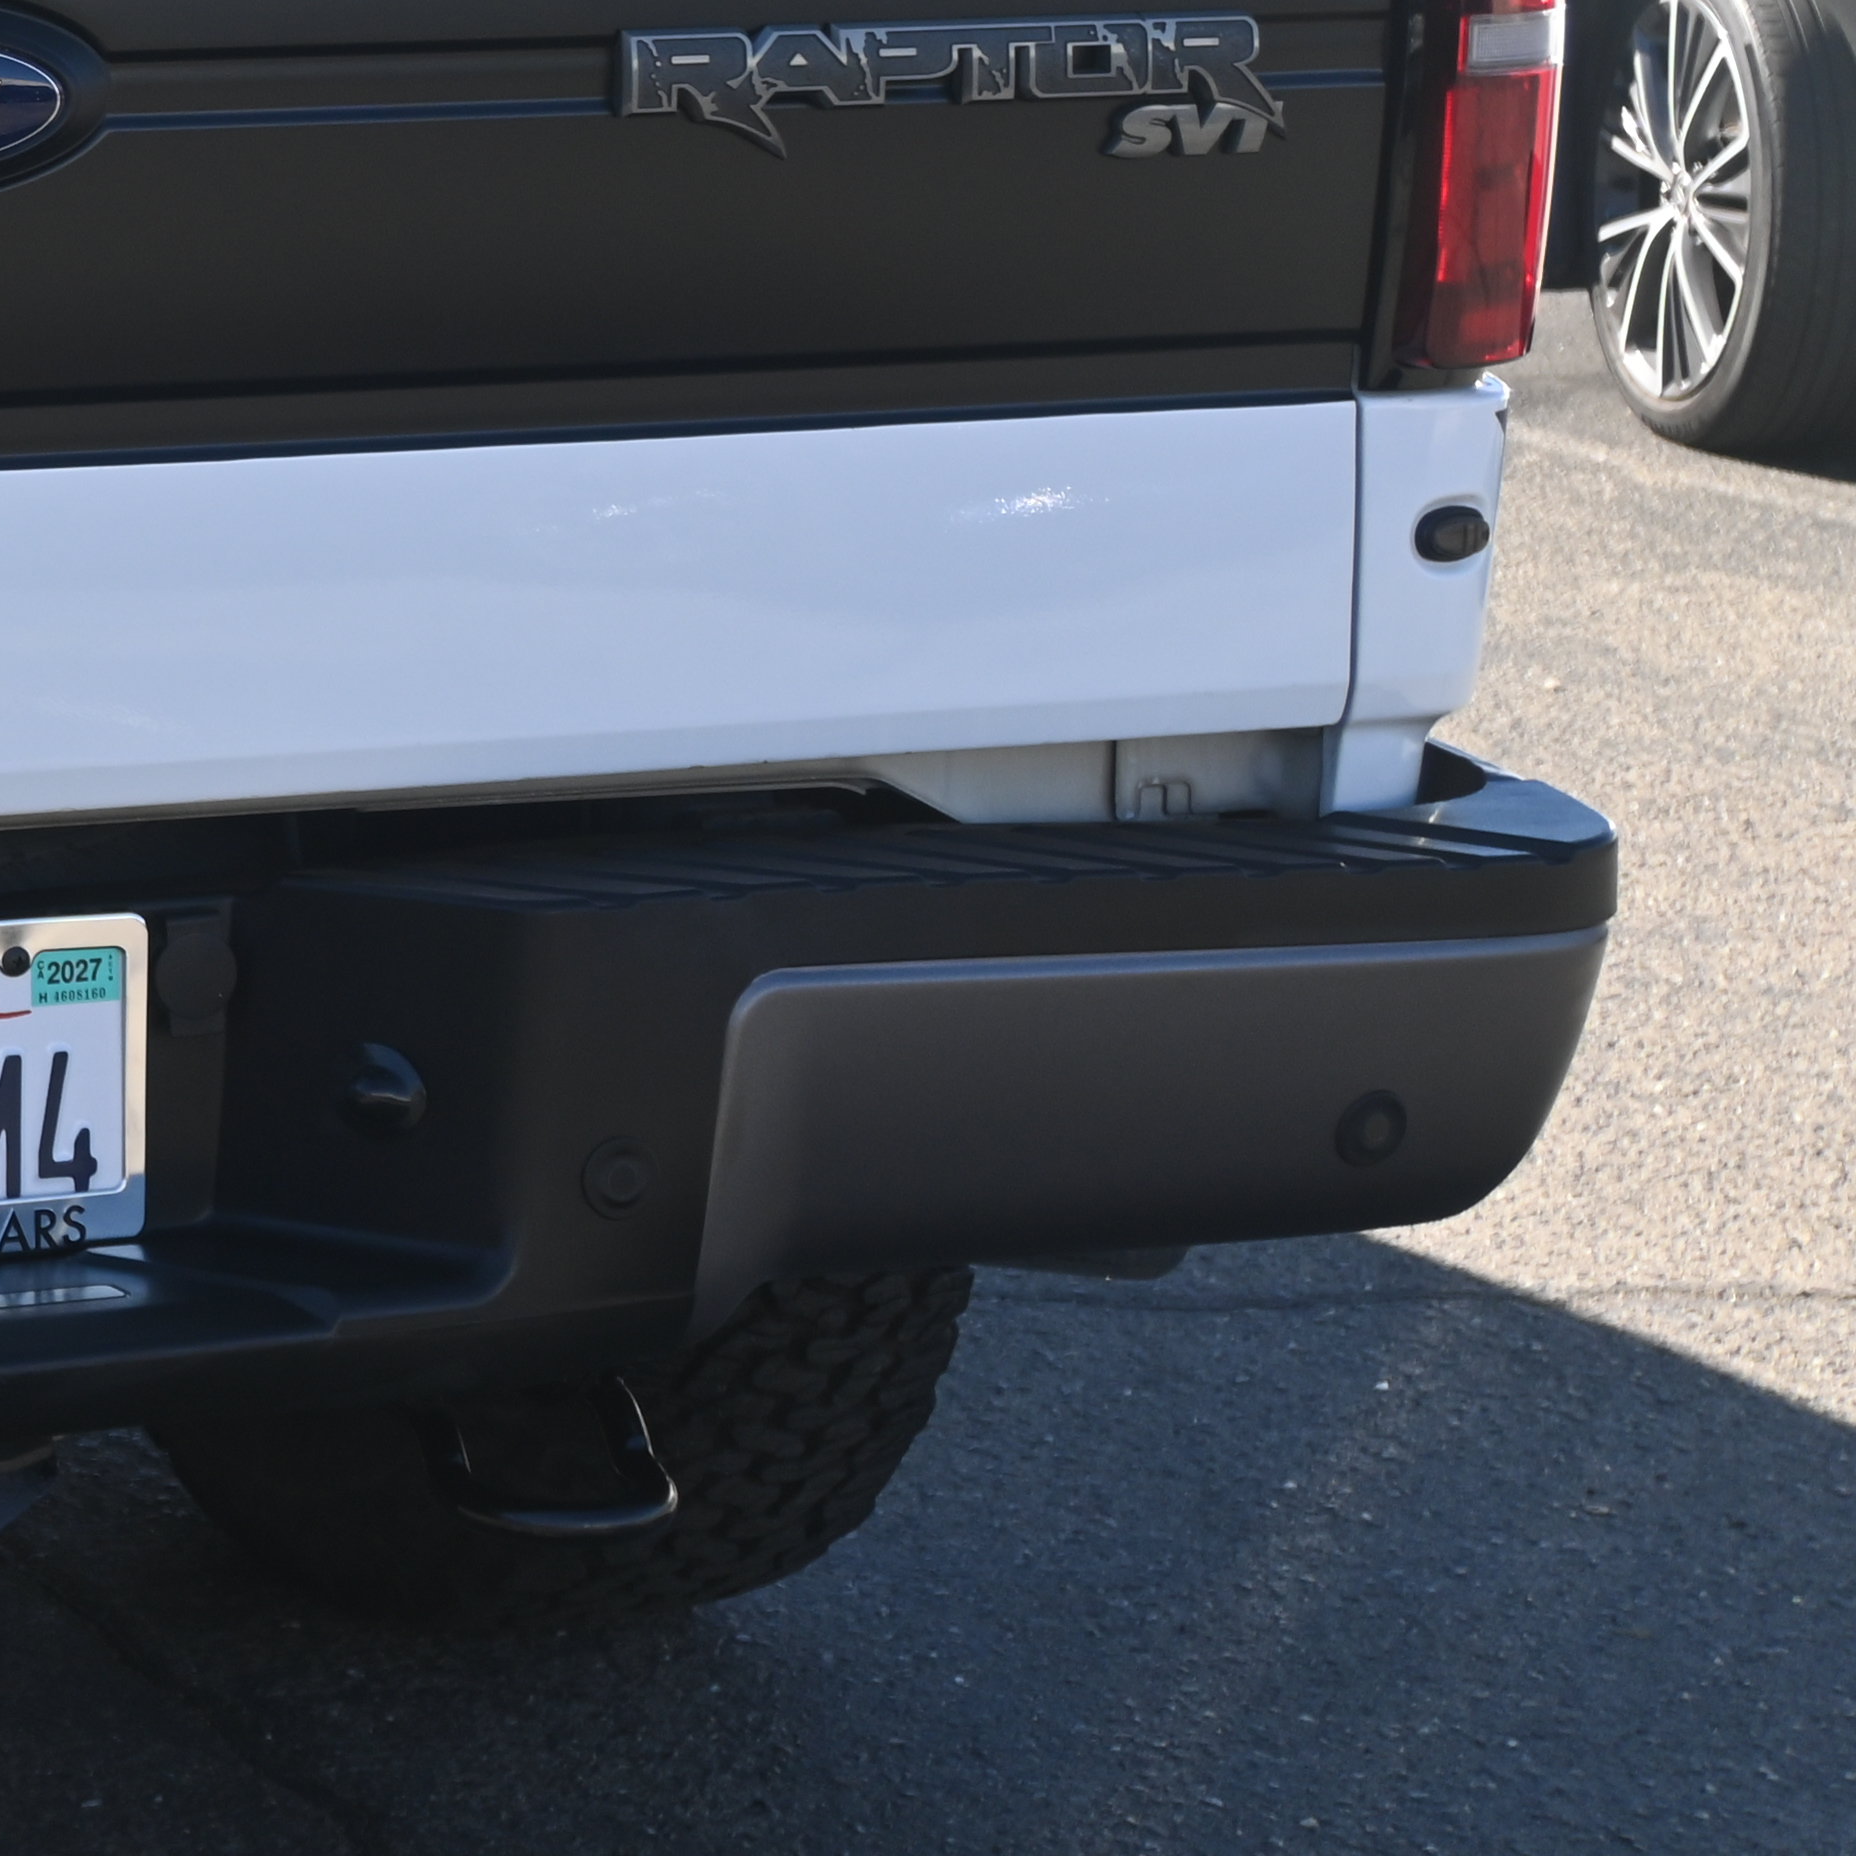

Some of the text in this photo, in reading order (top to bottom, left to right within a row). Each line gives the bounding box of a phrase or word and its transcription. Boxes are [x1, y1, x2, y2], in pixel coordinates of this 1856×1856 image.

[618, 10, 1286, 158] RAPTOR
[1106, 102, 1270, 157] SVT
[47, 957, 103, 985] 2027
